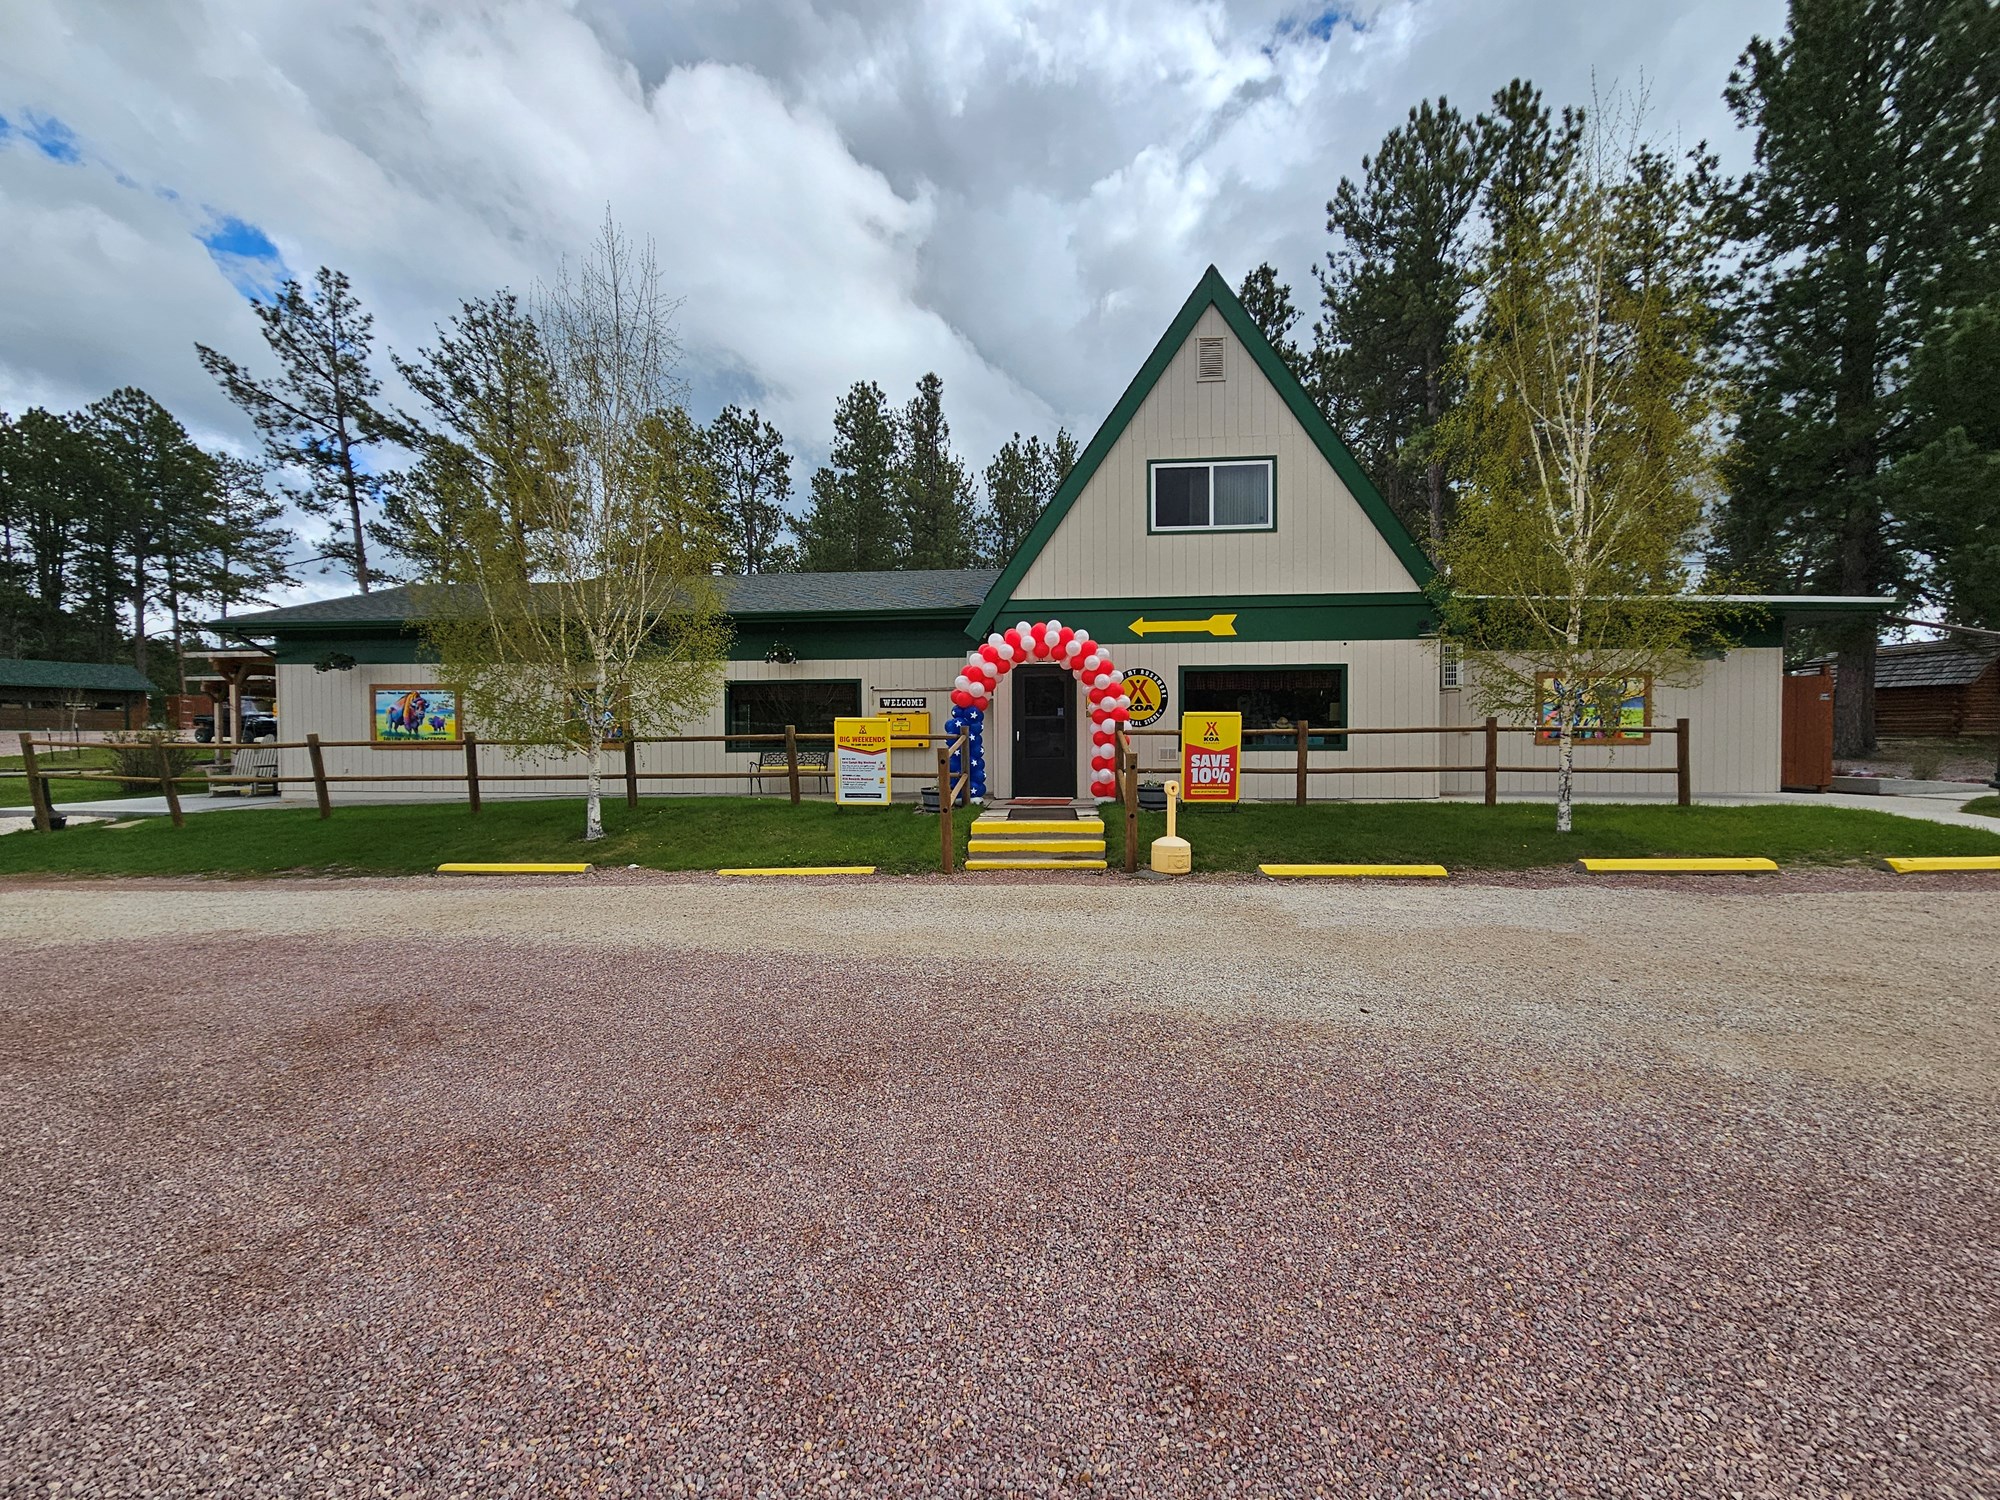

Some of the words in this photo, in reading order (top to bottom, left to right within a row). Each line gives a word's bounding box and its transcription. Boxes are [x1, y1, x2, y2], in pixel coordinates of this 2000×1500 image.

[1140, 669, 1167, 698] RUSHMORE
[883, 699, 924, 707] WELCOME
[1144, 712, 1160, 725] STORE
[1191, 754, 1230, 767] SAVE
